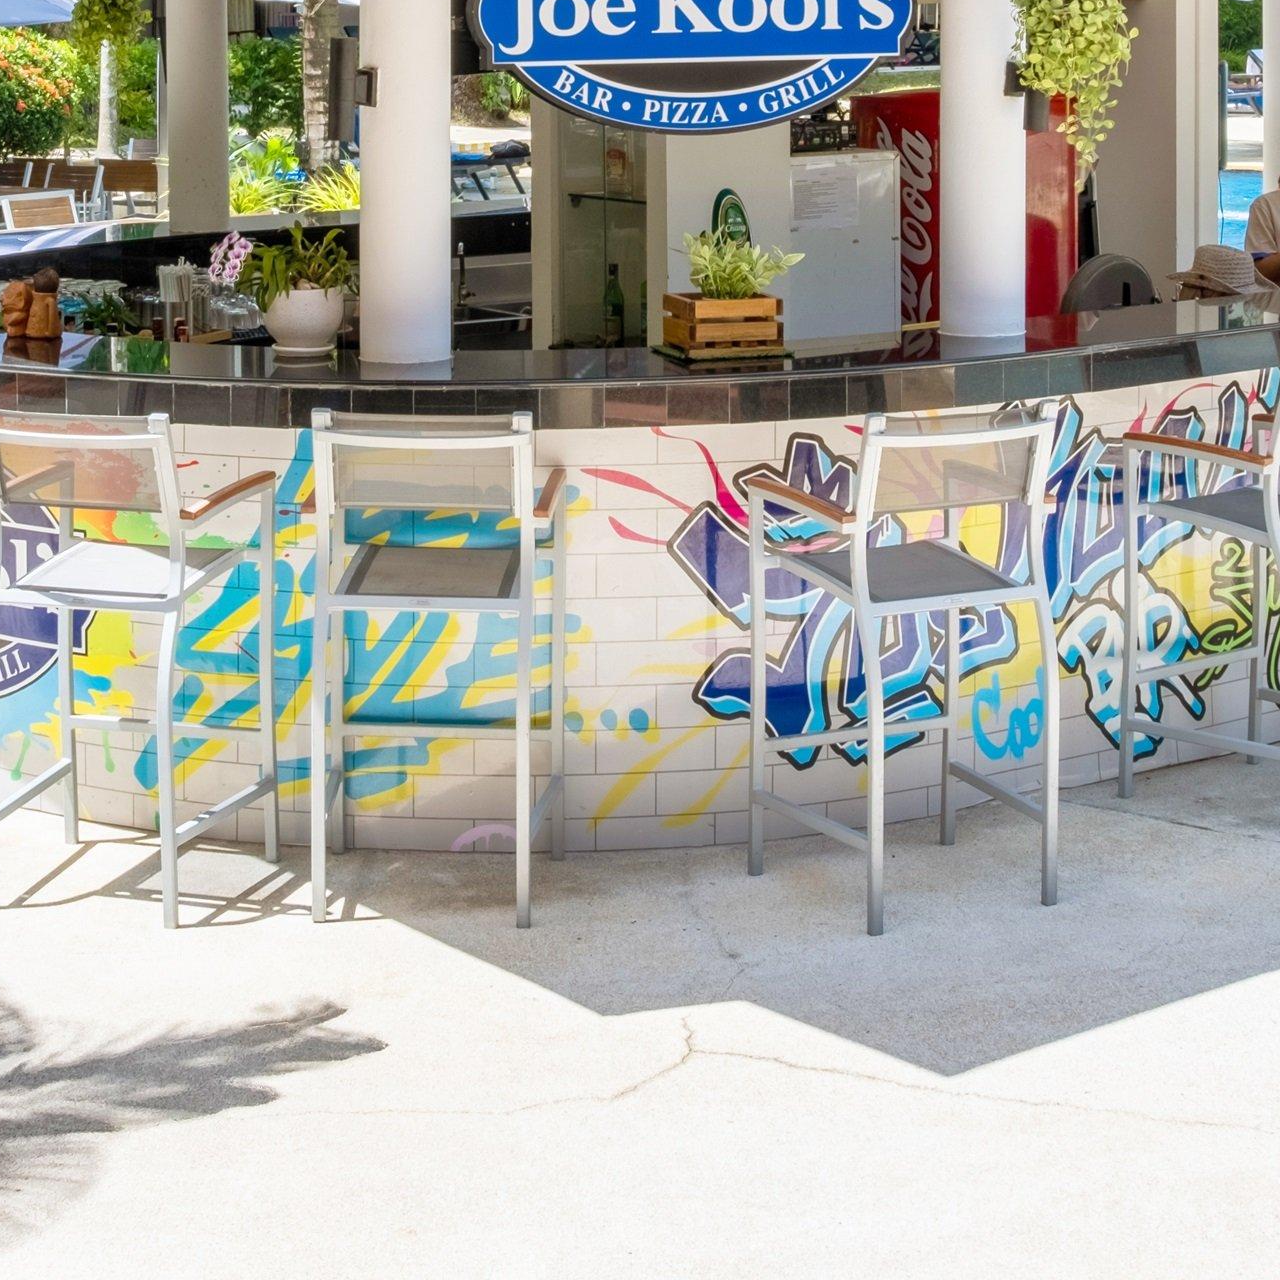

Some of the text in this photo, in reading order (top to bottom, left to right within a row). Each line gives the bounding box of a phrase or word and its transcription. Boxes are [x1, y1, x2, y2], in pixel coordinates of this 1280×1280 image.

[552, 63, 846, 124] BAR PIZZA GRILL
